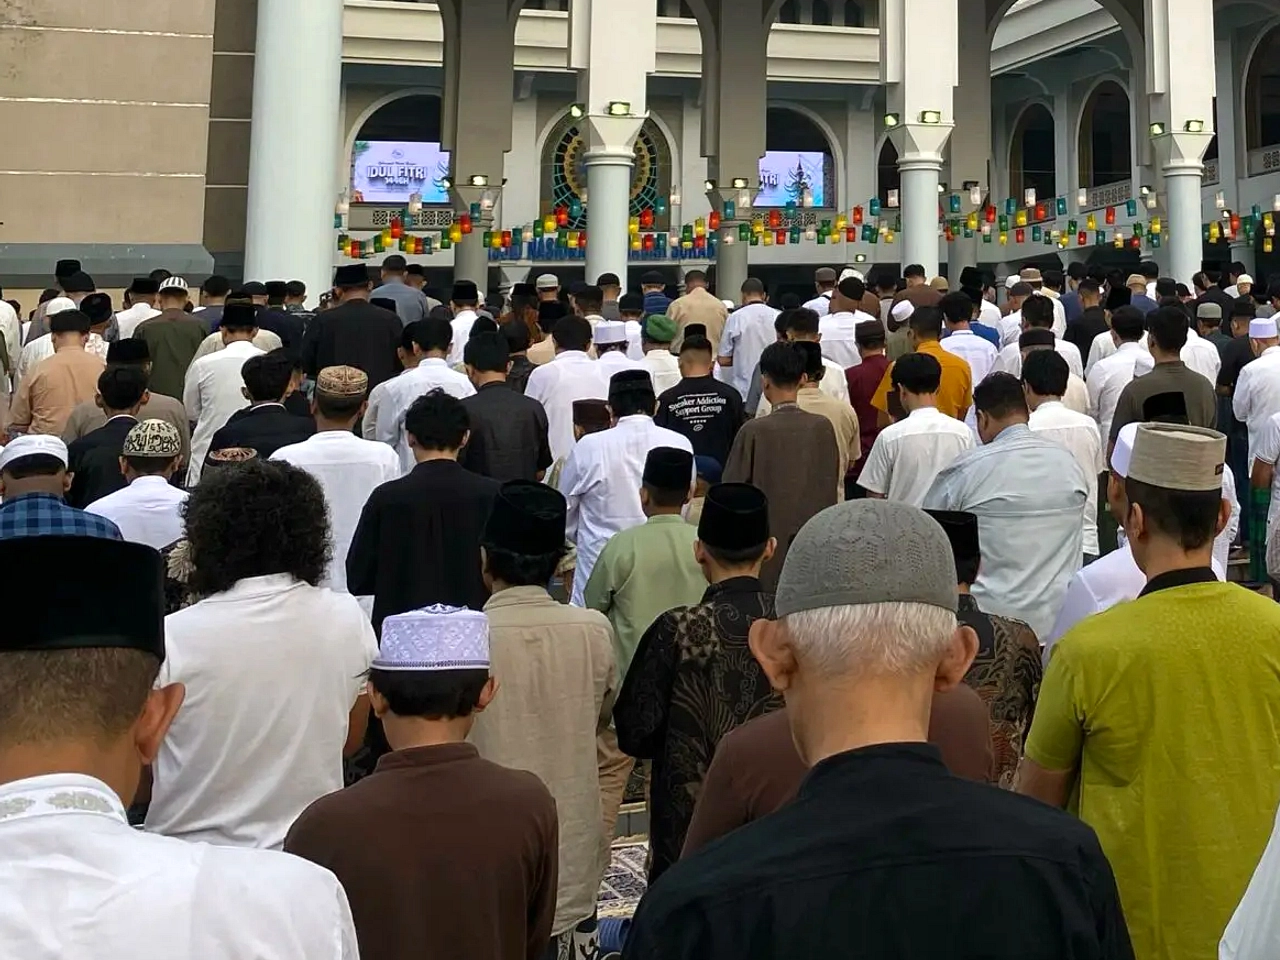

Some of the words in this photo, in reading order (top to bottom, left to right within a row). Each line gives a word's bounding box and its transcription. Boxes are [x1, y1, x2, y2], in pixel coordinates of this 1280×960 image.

[367, 165, 394, 178] IDUL
[398, 165, 427, 180] FITRI
[696, 396, 727, 405] Addiction
[675, 406, 700, 417] Support
[701, 405, 722, 414] Group
